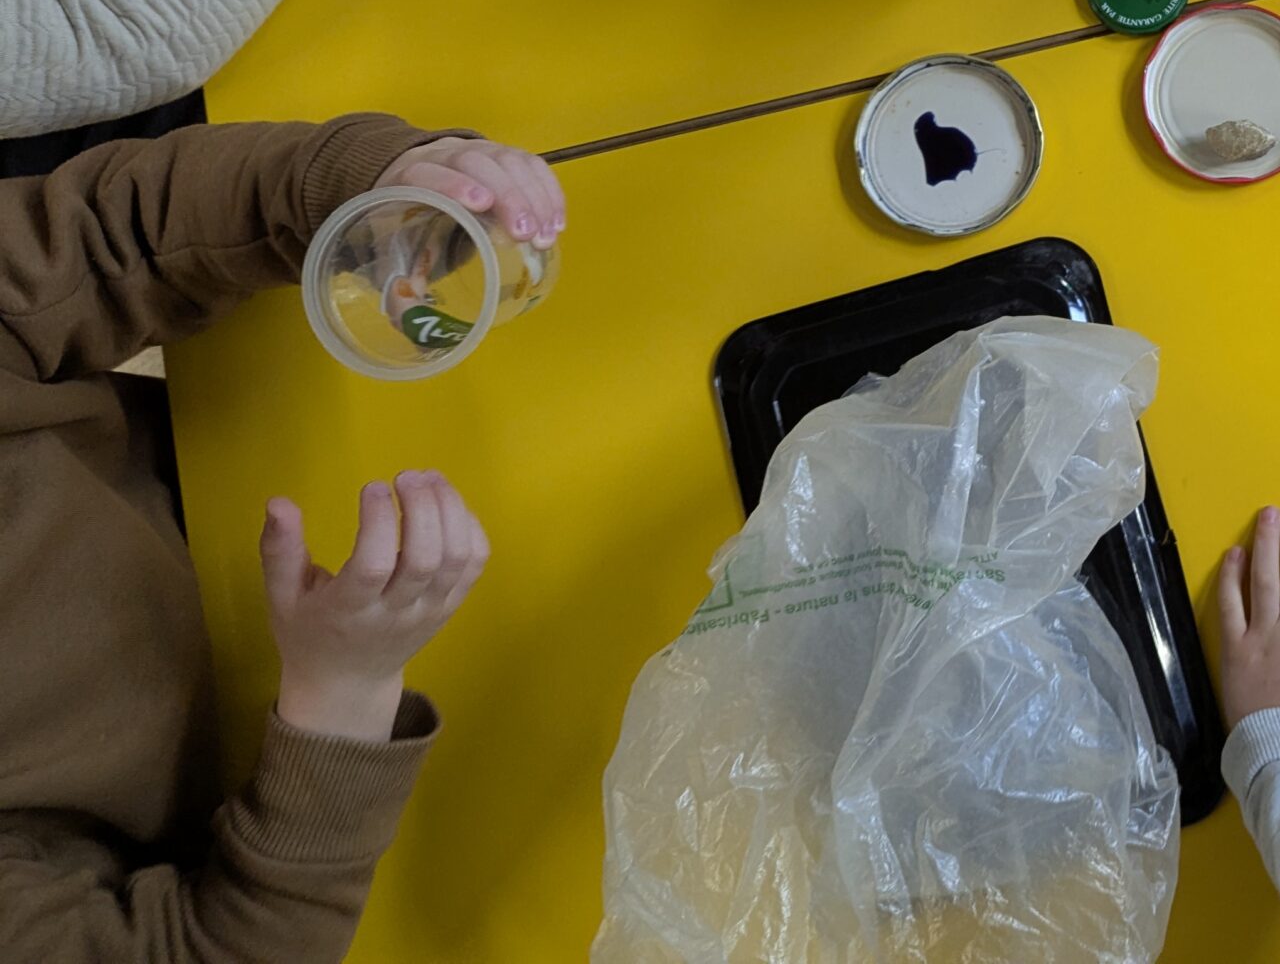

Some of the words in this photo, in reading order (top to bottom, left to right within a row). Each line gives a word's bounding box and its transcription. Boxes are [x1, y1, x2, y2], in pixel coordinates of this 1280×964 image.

[1101, 2, 1117, 18] PAR
[1118, 13, 1162, 27] GARANTIE
[844, 589, 857, 603] la
[784, 594, 839, 614] nature
